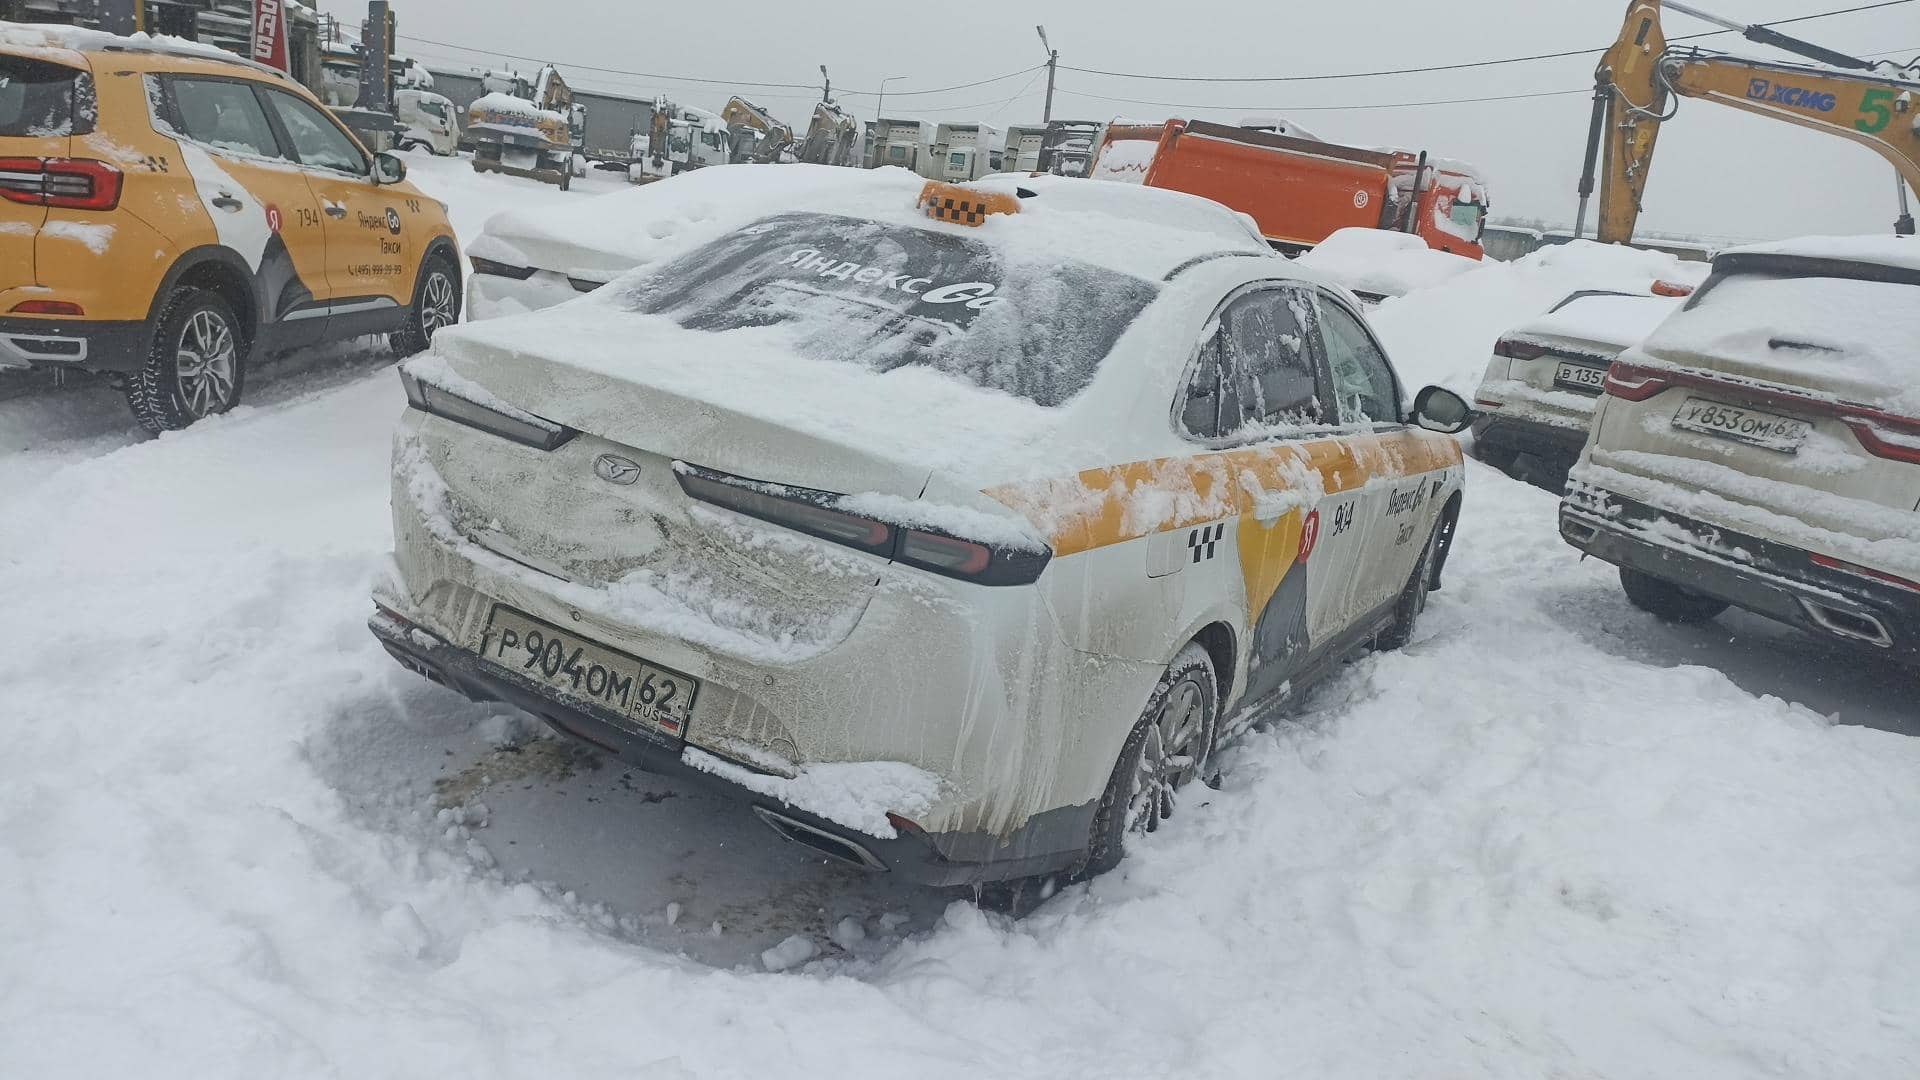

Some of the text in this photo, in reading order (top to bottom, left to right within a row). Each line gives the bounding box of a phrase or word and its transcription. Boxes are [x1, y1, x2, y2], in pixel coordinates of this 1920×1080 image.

[1767, 85, 1836, 112] XCMG
[1854, 88, 1896, 134] 5
[296, 208, 319, 228] 794
[357, 210, 400, 231] Яндекс Go
[379, 237, 401, 254] Такси
[778, 248, 933, 294] Яндекс
[1562, 368, 1606, 386] В135
[639, 673, 677, 714] 62
[633, 702, 660, 723] RUS
